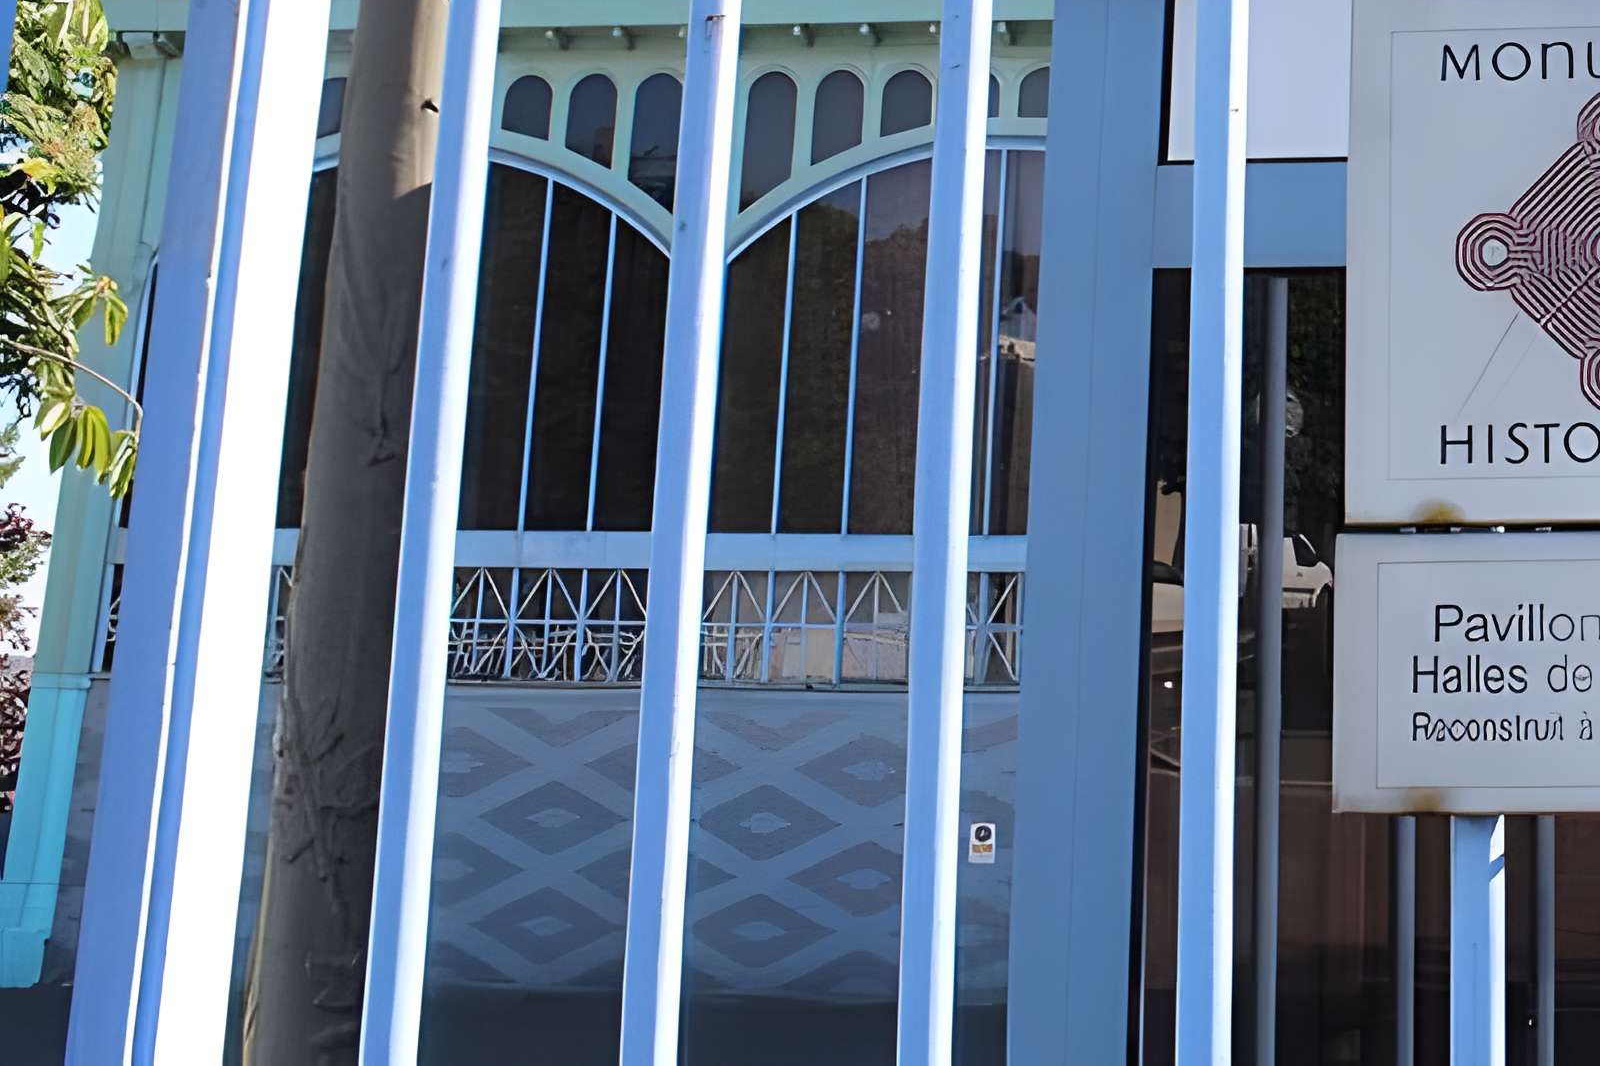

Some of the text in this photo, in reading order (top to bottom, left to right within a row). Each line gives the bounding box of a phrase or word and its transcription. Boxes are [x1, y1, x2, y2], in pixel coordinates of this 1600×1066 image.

[1412, 653, 1528, 695] Halles
[1546, 653, 1593, 694] de
[1578, 710, 1593, 741] à
